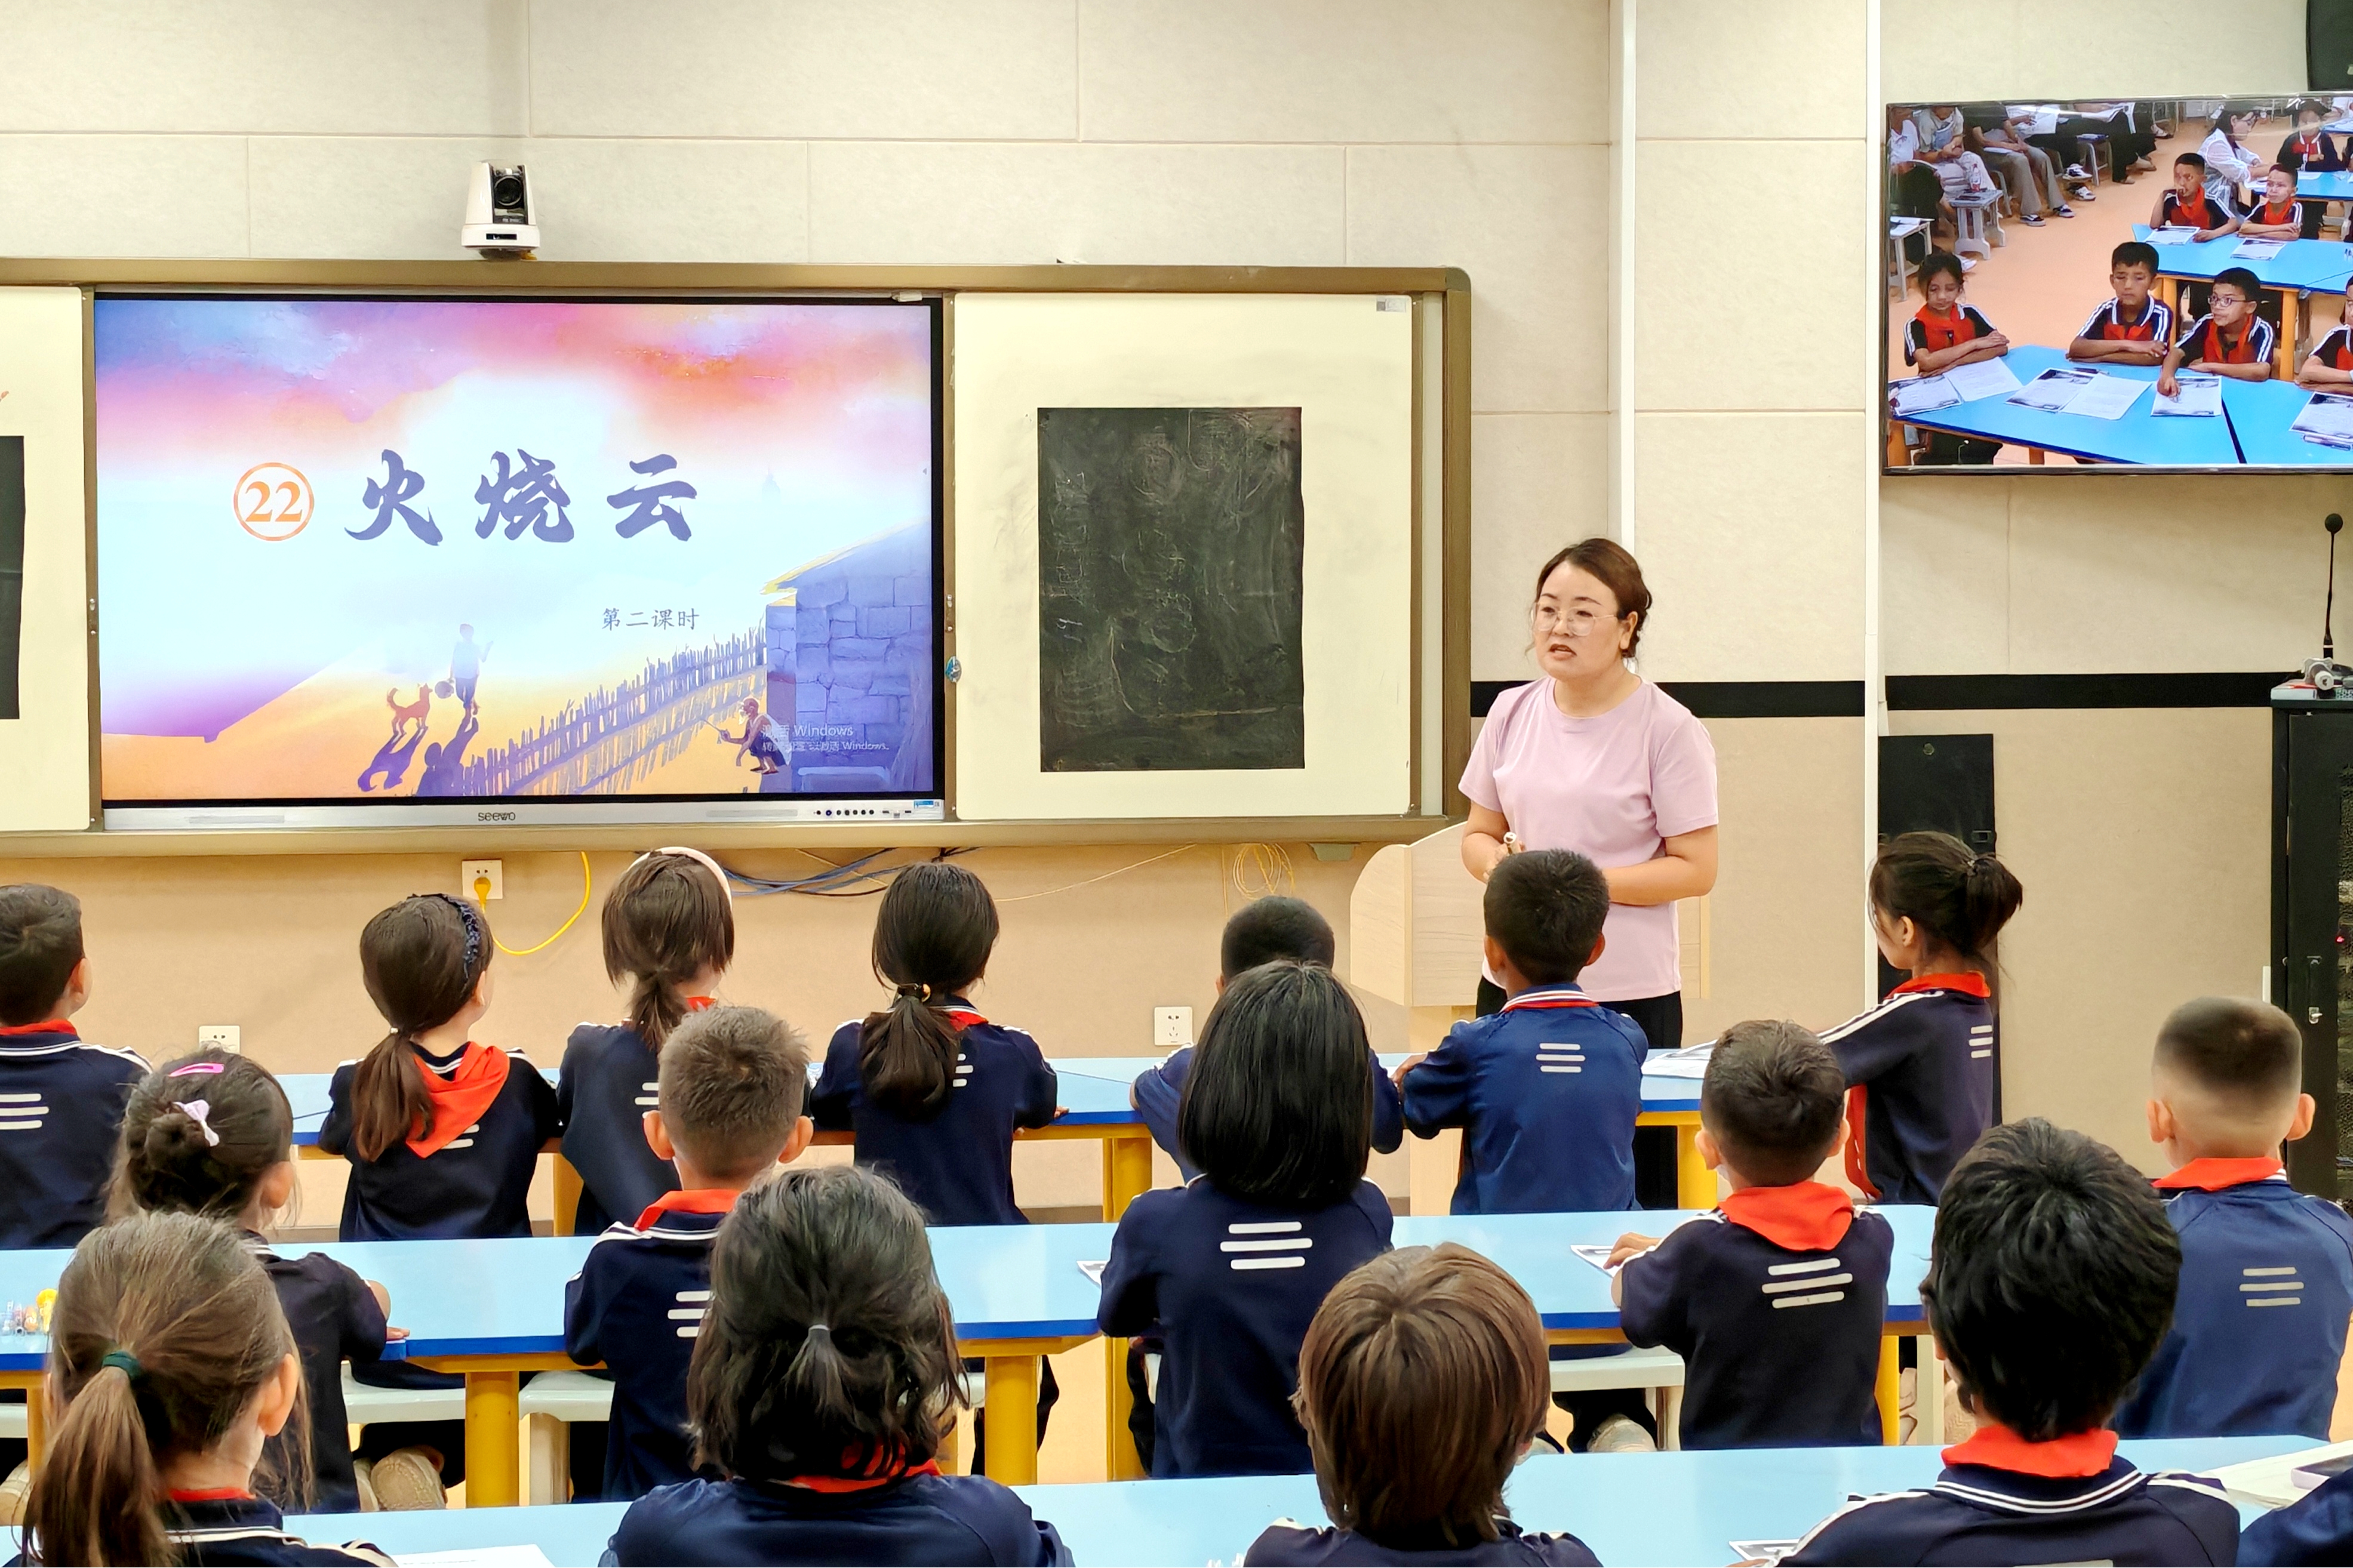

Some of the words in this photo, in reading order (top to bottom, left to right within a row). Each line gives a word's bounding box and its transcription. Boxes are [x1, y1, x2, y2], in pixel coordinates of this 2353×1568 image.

[244, 480, 303, 523] 22
[345, 448, 697, 546] 火烧云
[601, 607, 700, 631] 第二课时
[793, 723, 854, 737] Windows
[478, 812, 516, 822] seewo
